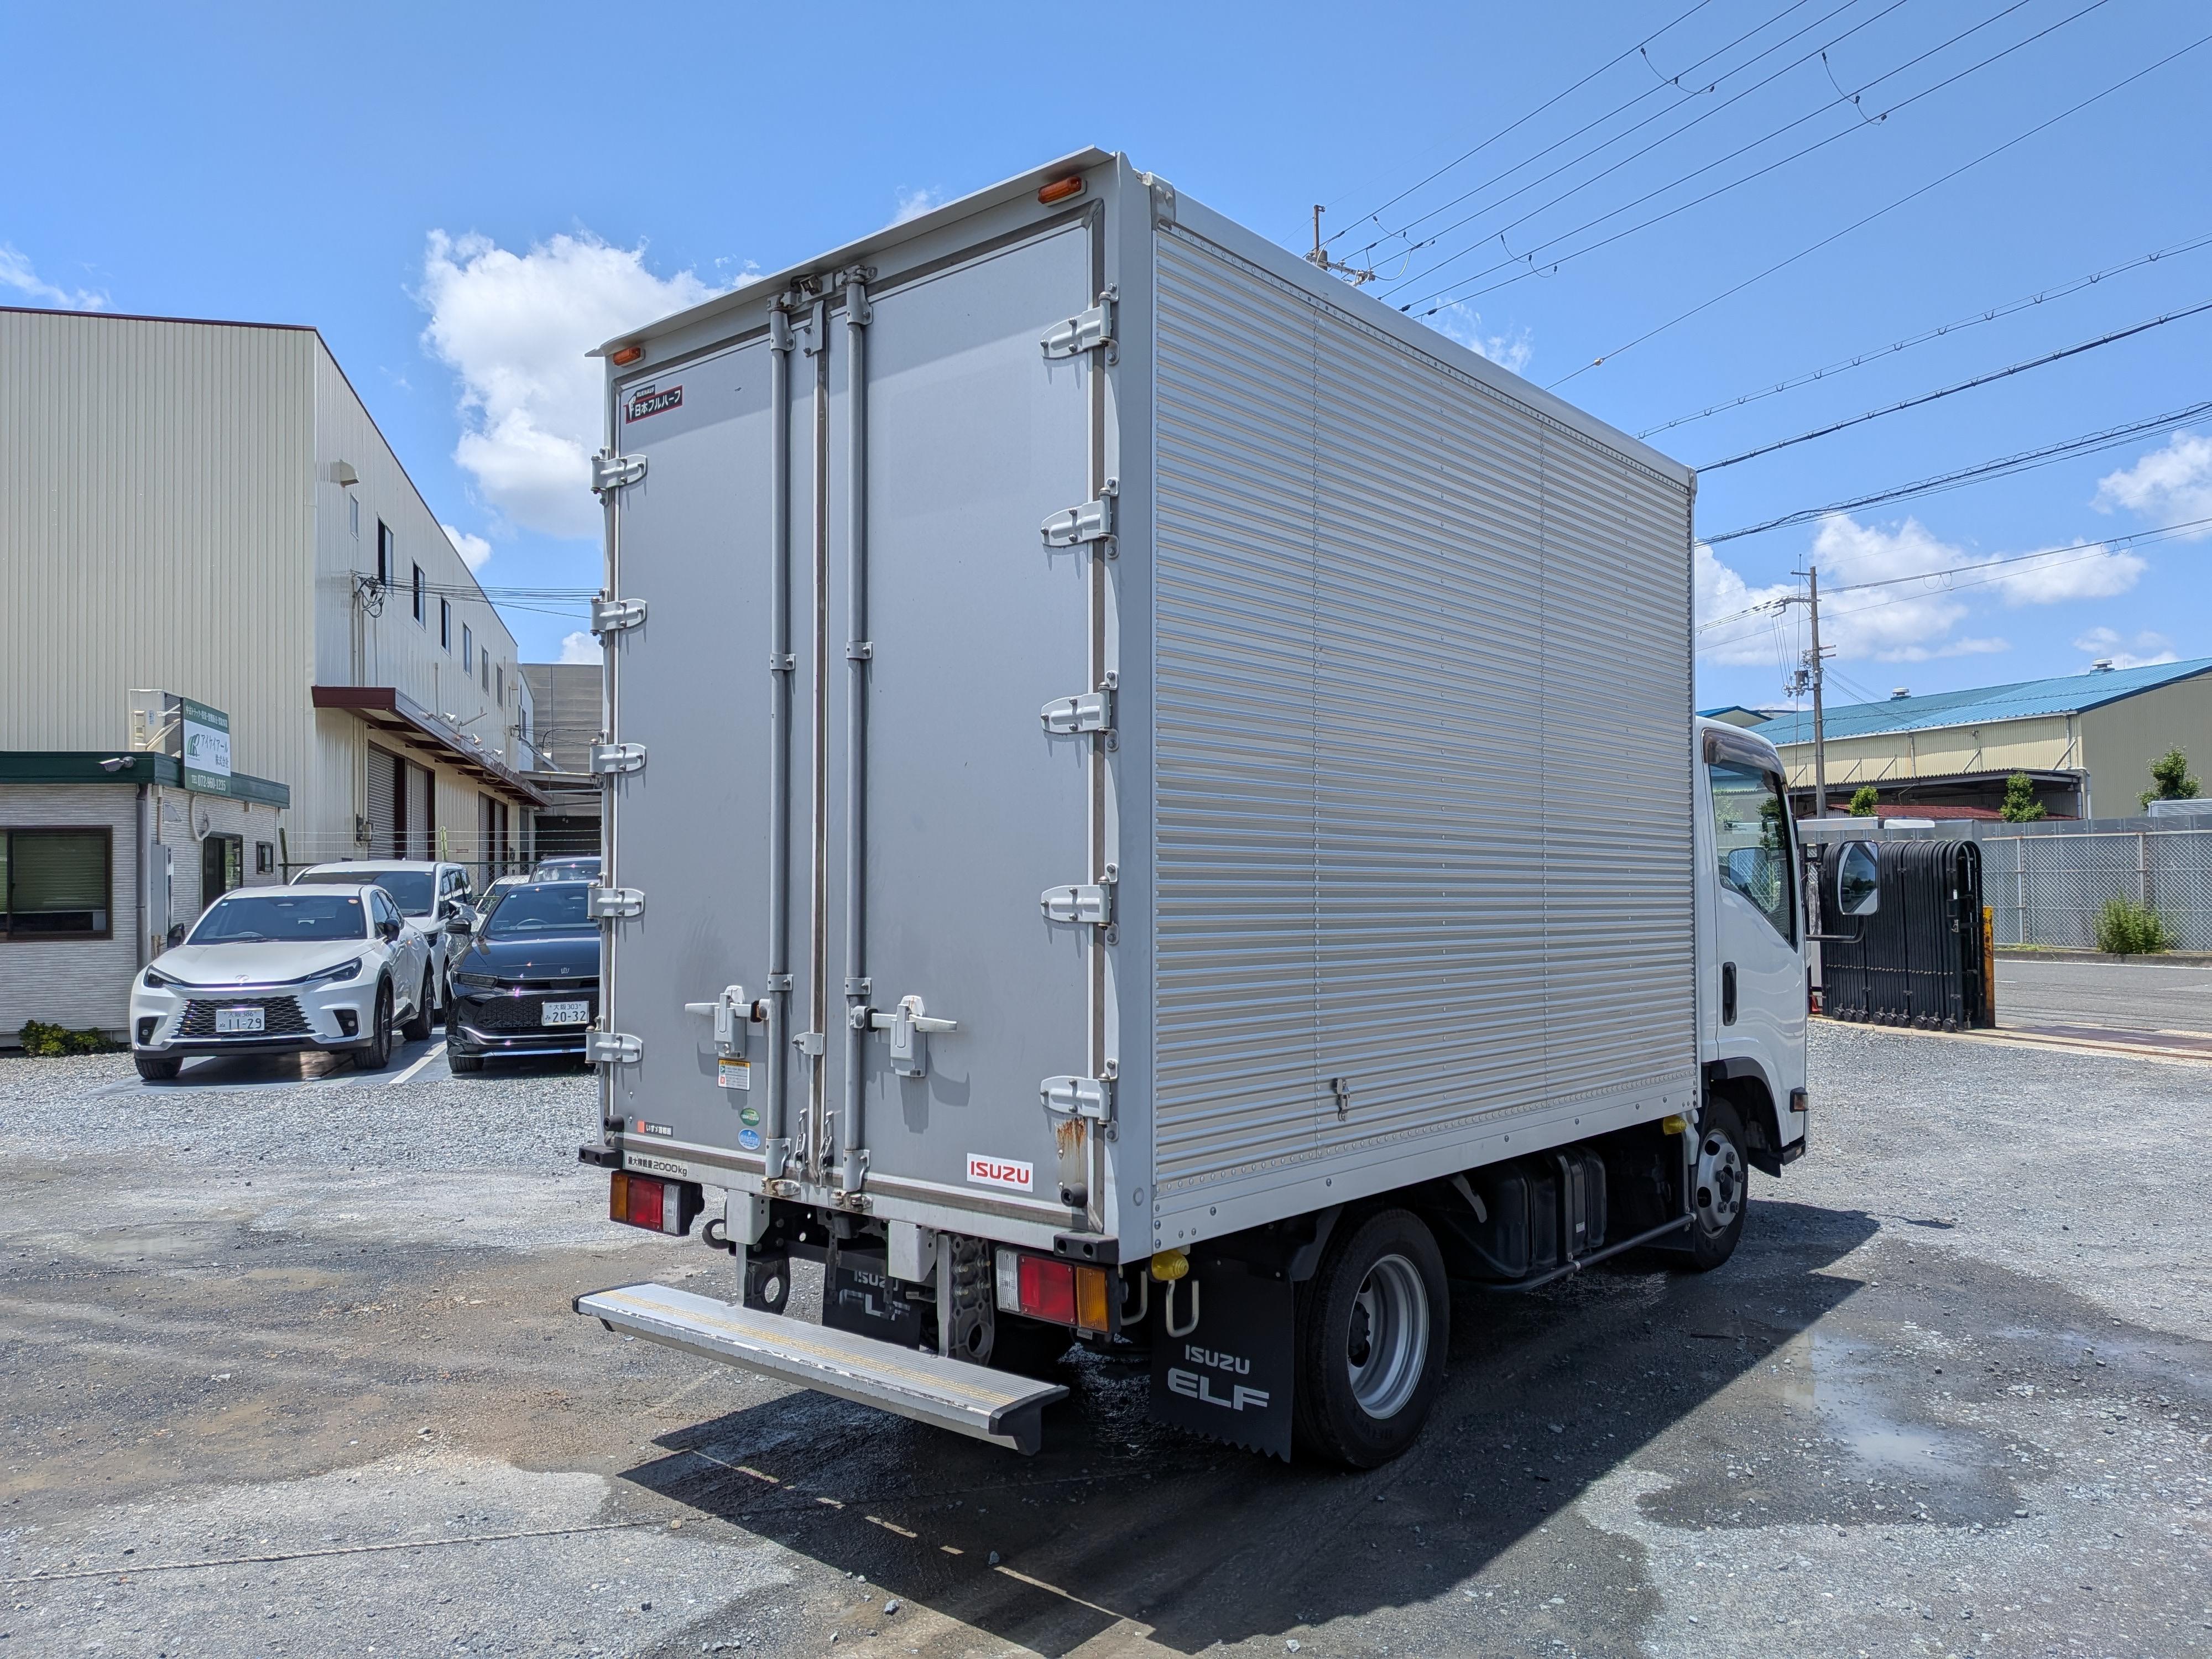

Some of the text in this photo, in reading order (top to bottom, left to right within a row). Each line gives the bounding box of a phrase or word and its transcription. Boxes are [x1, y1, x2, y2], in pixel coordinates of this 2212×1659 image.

[635, 390, 681, 417] 日本フルハーフ
[201, 734, 228, 753] アイケイアール
[215, 754, 229, 768] 株式会社
[229, 1018, 262, 1030] 11-29
[552, 1011, 586, 1022] 20-32
[971, 1161, 1029, 1184] ISUZU
[1185, 1344, 1250, 1375] ISUZU
[1167, 1368, 1269, 1411] ELF
